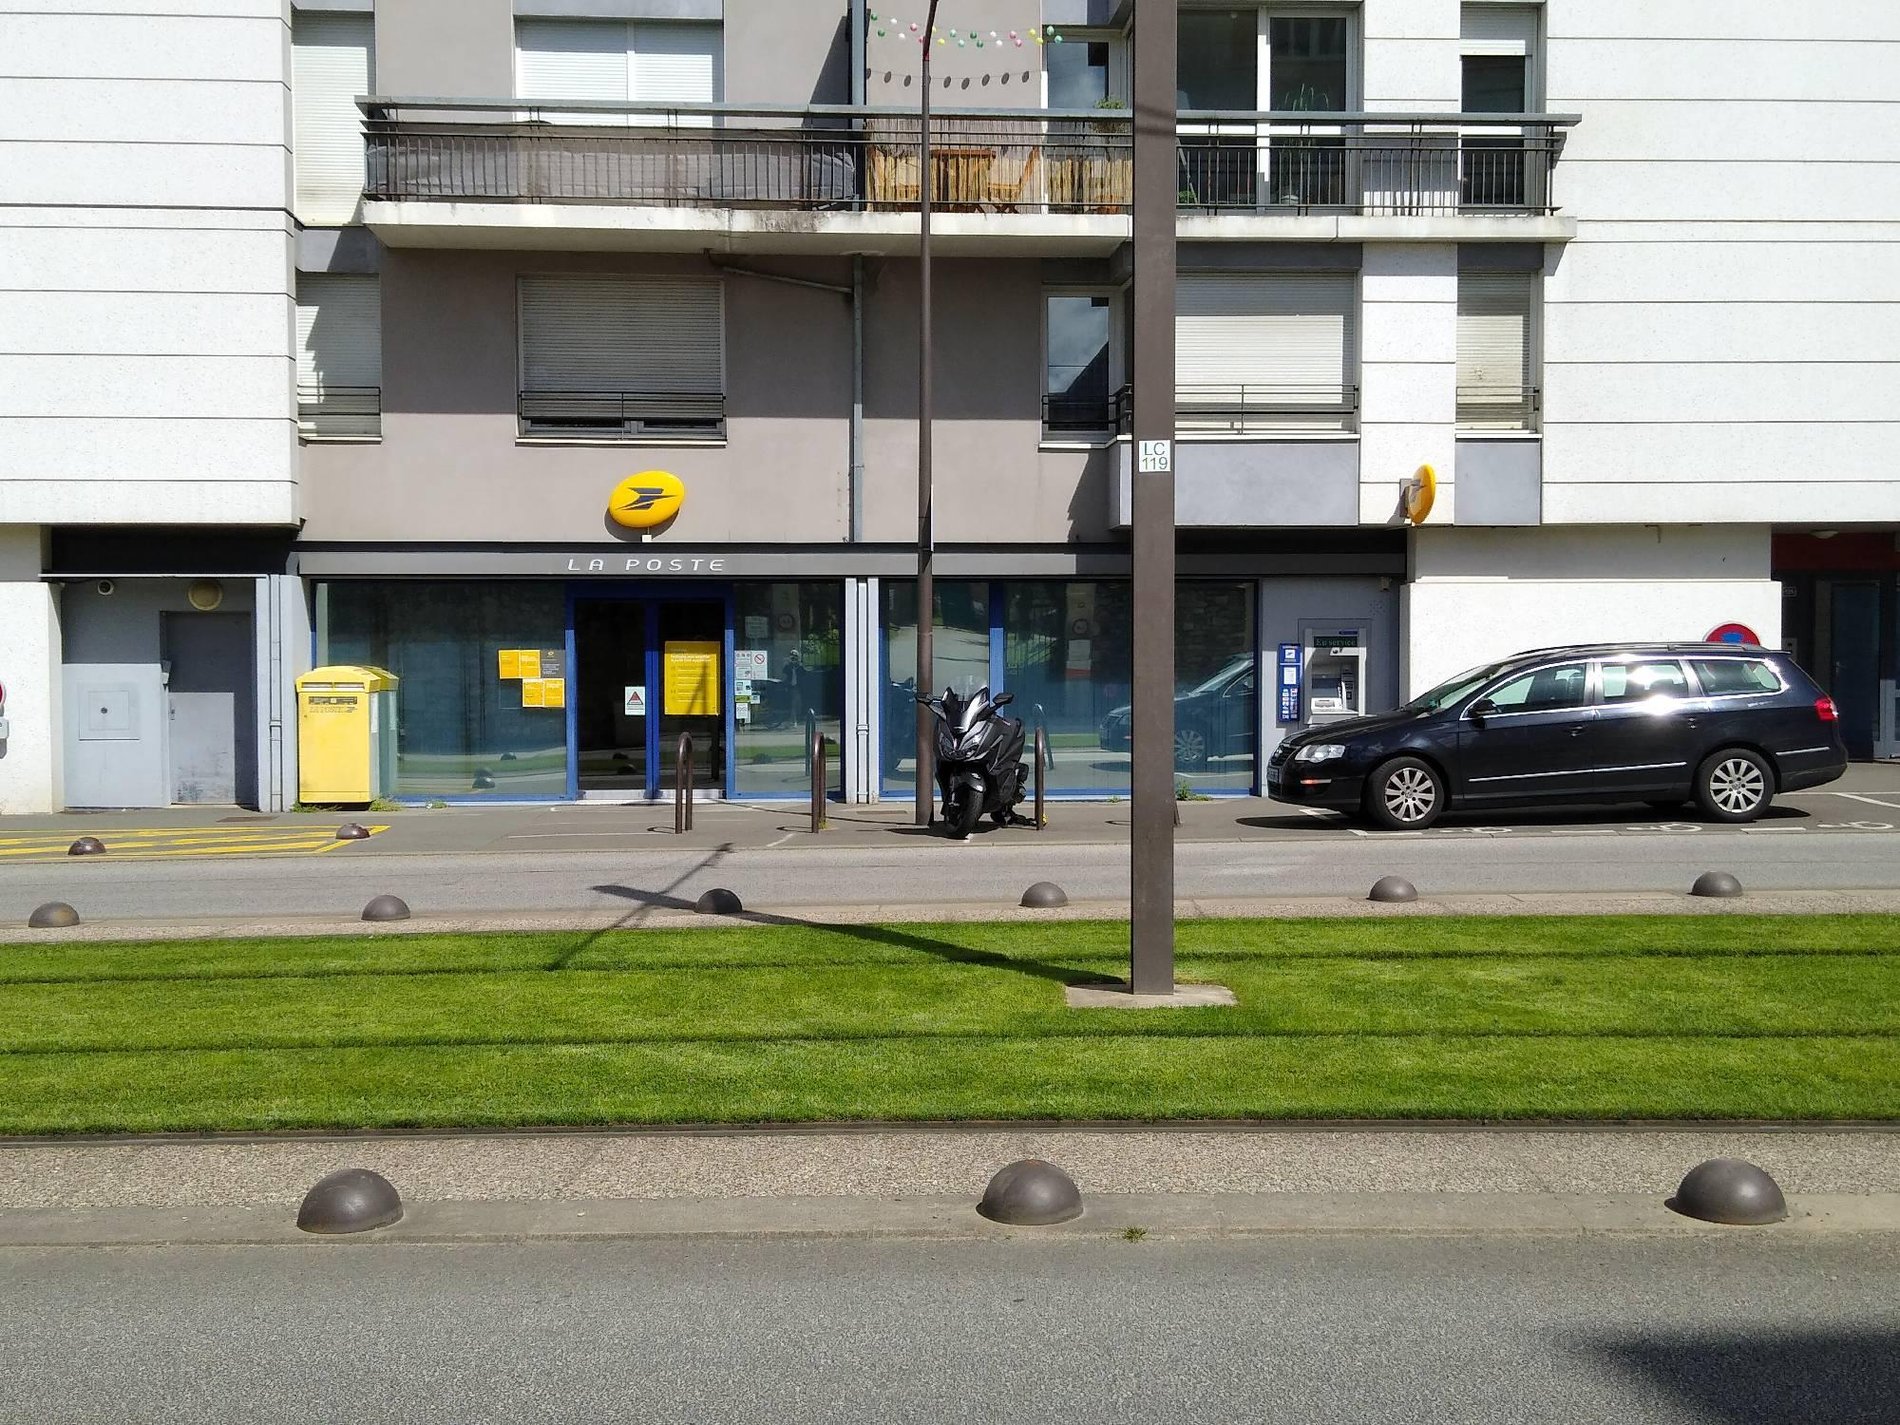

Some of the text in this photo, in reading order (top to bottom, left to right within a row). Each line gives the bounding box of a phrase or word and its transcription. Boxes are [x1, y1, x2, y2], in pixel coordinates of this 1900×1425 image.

[1144, 442, 1165, 456] LC
[1142, 457, 1168, 470] 119
[567, 558, 725, 571] LA POSTE
